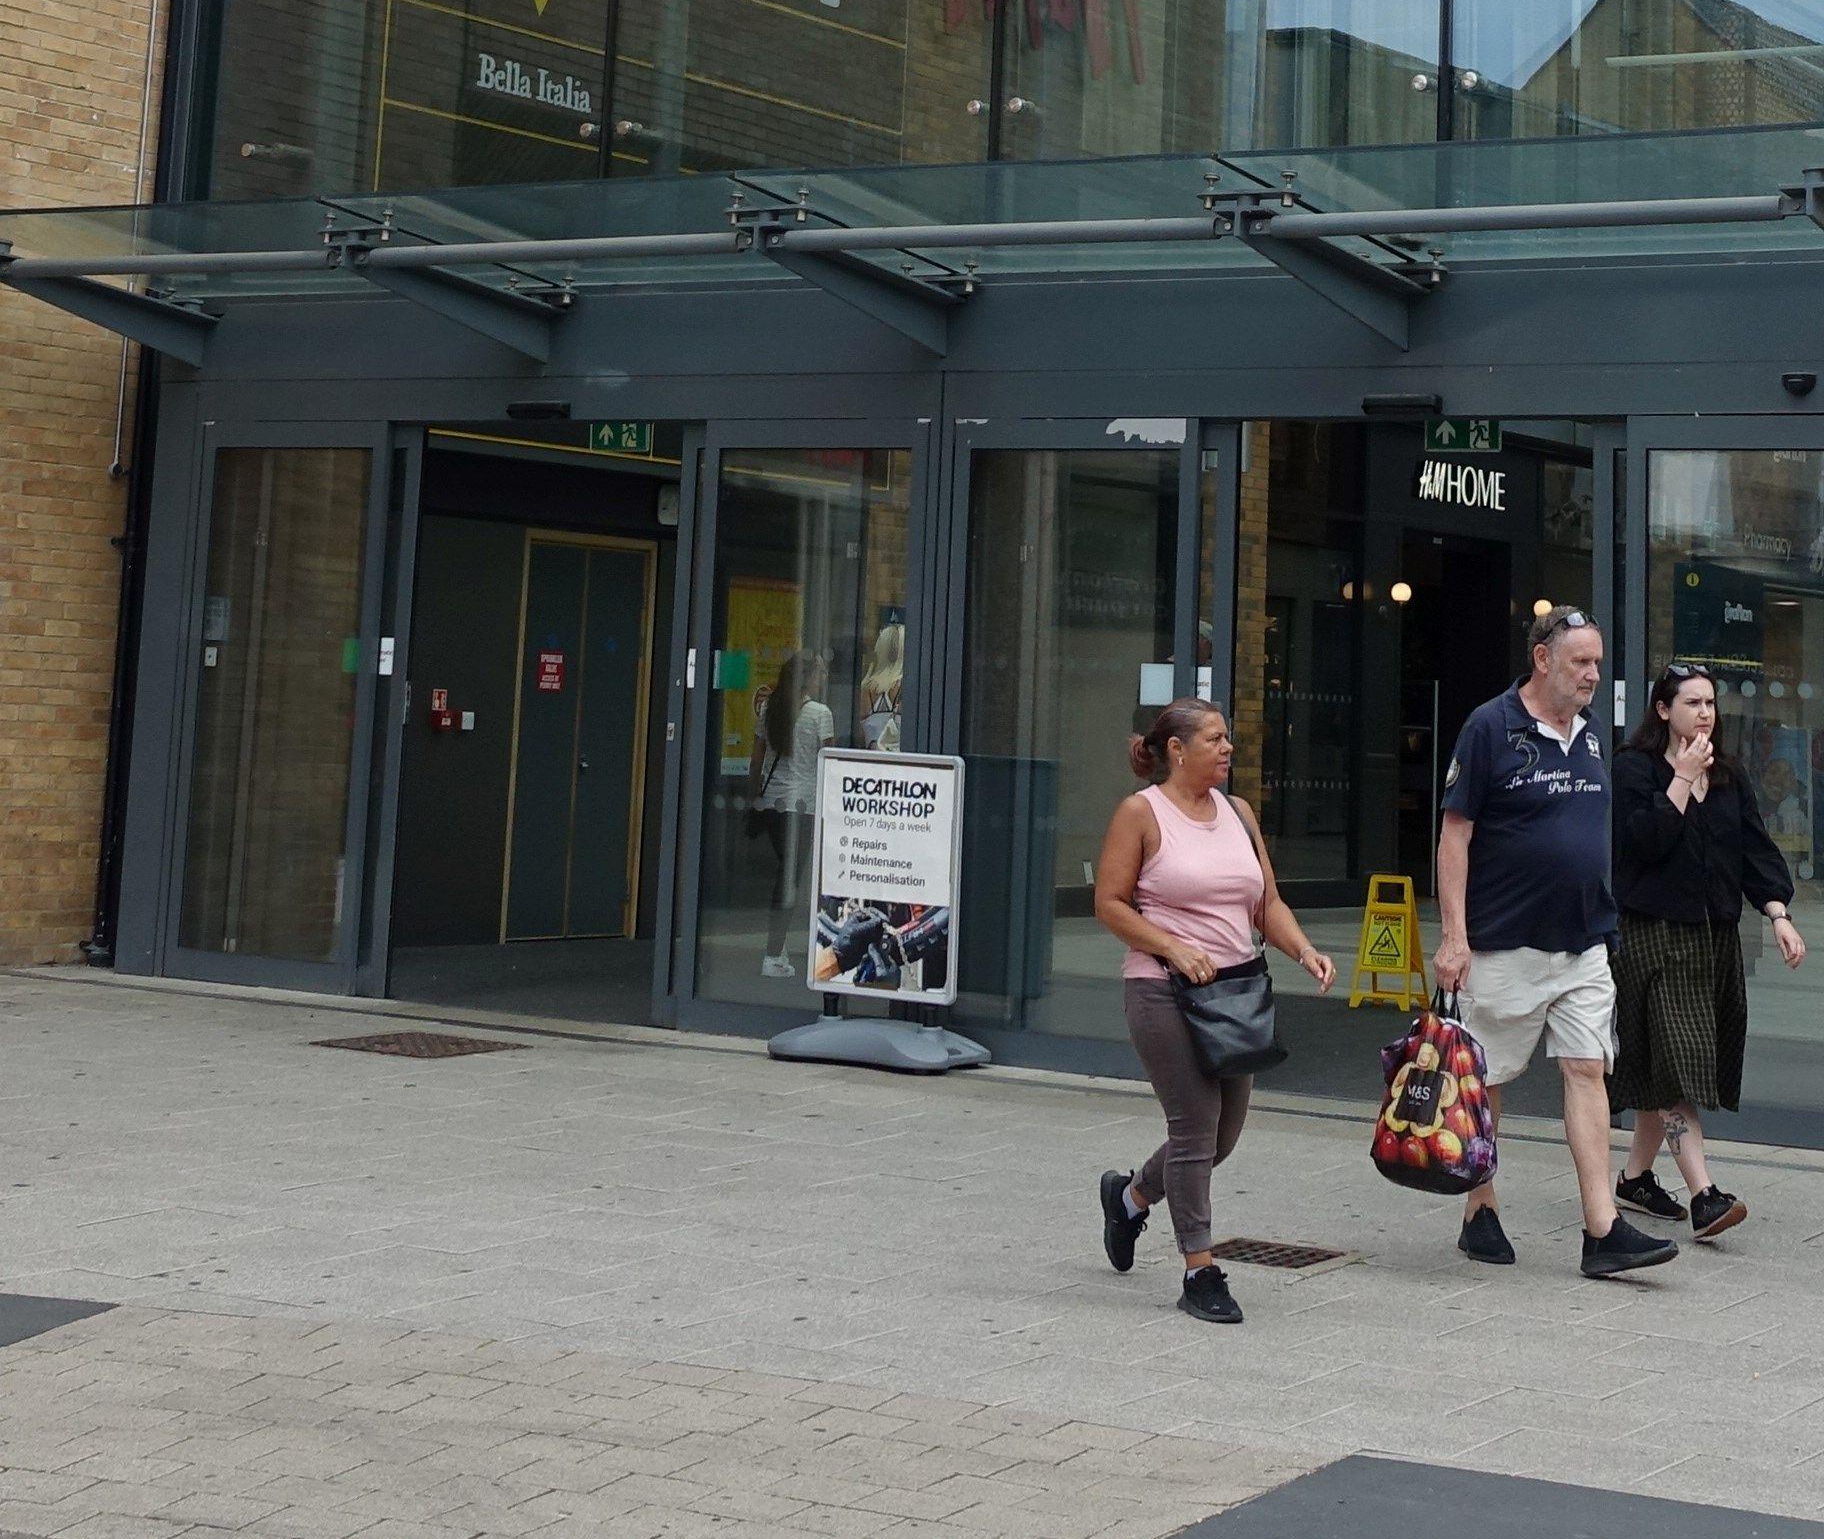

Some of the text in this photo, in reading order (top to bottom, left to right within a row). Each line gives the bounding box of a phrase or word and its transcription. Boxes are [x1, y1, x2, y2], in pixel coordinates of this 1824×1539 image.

[476, 53, 592, 114] Bella Italia
[1447, 463, 1506, 511] HOME
[842, 776, 937, 800] DECATHLON
[1548, 778, 1601, 795] Polo Team
[843, 796, 934, 819] WORKSHOP
[844, 815, 866, 828] Open
[876, 818, 896, 832] days
[907, 822, 931, 833] week
[852, 837, 888, 851] Repairs
[851, 854, 913, 869] Maintenance
[849, 869, 925, 887] Personalisation
